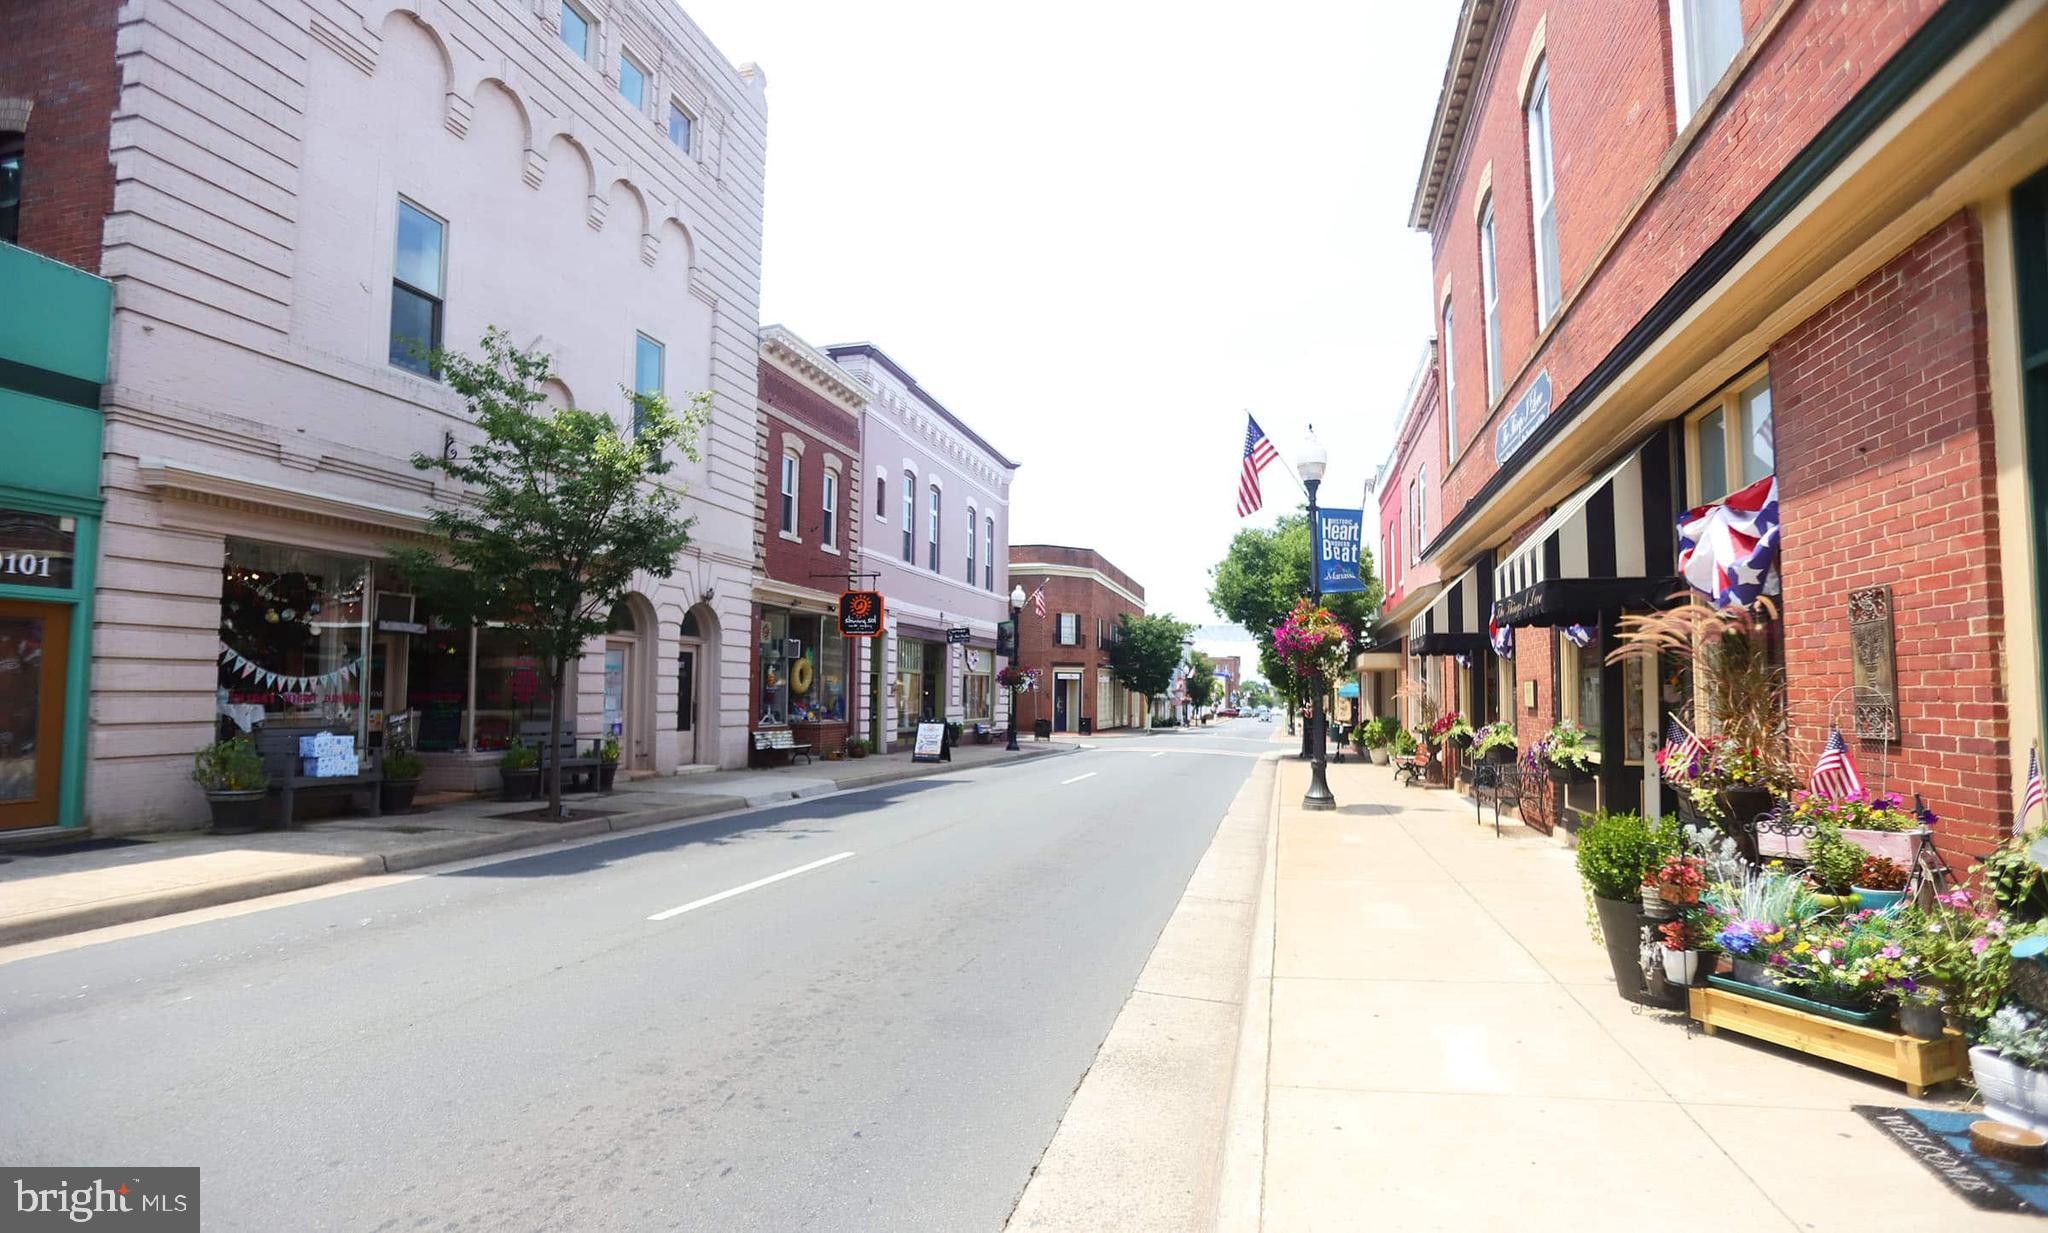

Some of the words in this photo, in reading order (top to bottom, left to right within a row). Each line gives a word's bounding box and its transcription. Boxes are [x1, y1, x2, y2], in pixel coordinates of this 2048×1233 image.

[1322, 517, 1360, 541] Heart
[1322, 539, 1358, 563] Beat
[0, 552, 51, 577] 101
[1876, 1115, 1996, 1192] WELCOME
